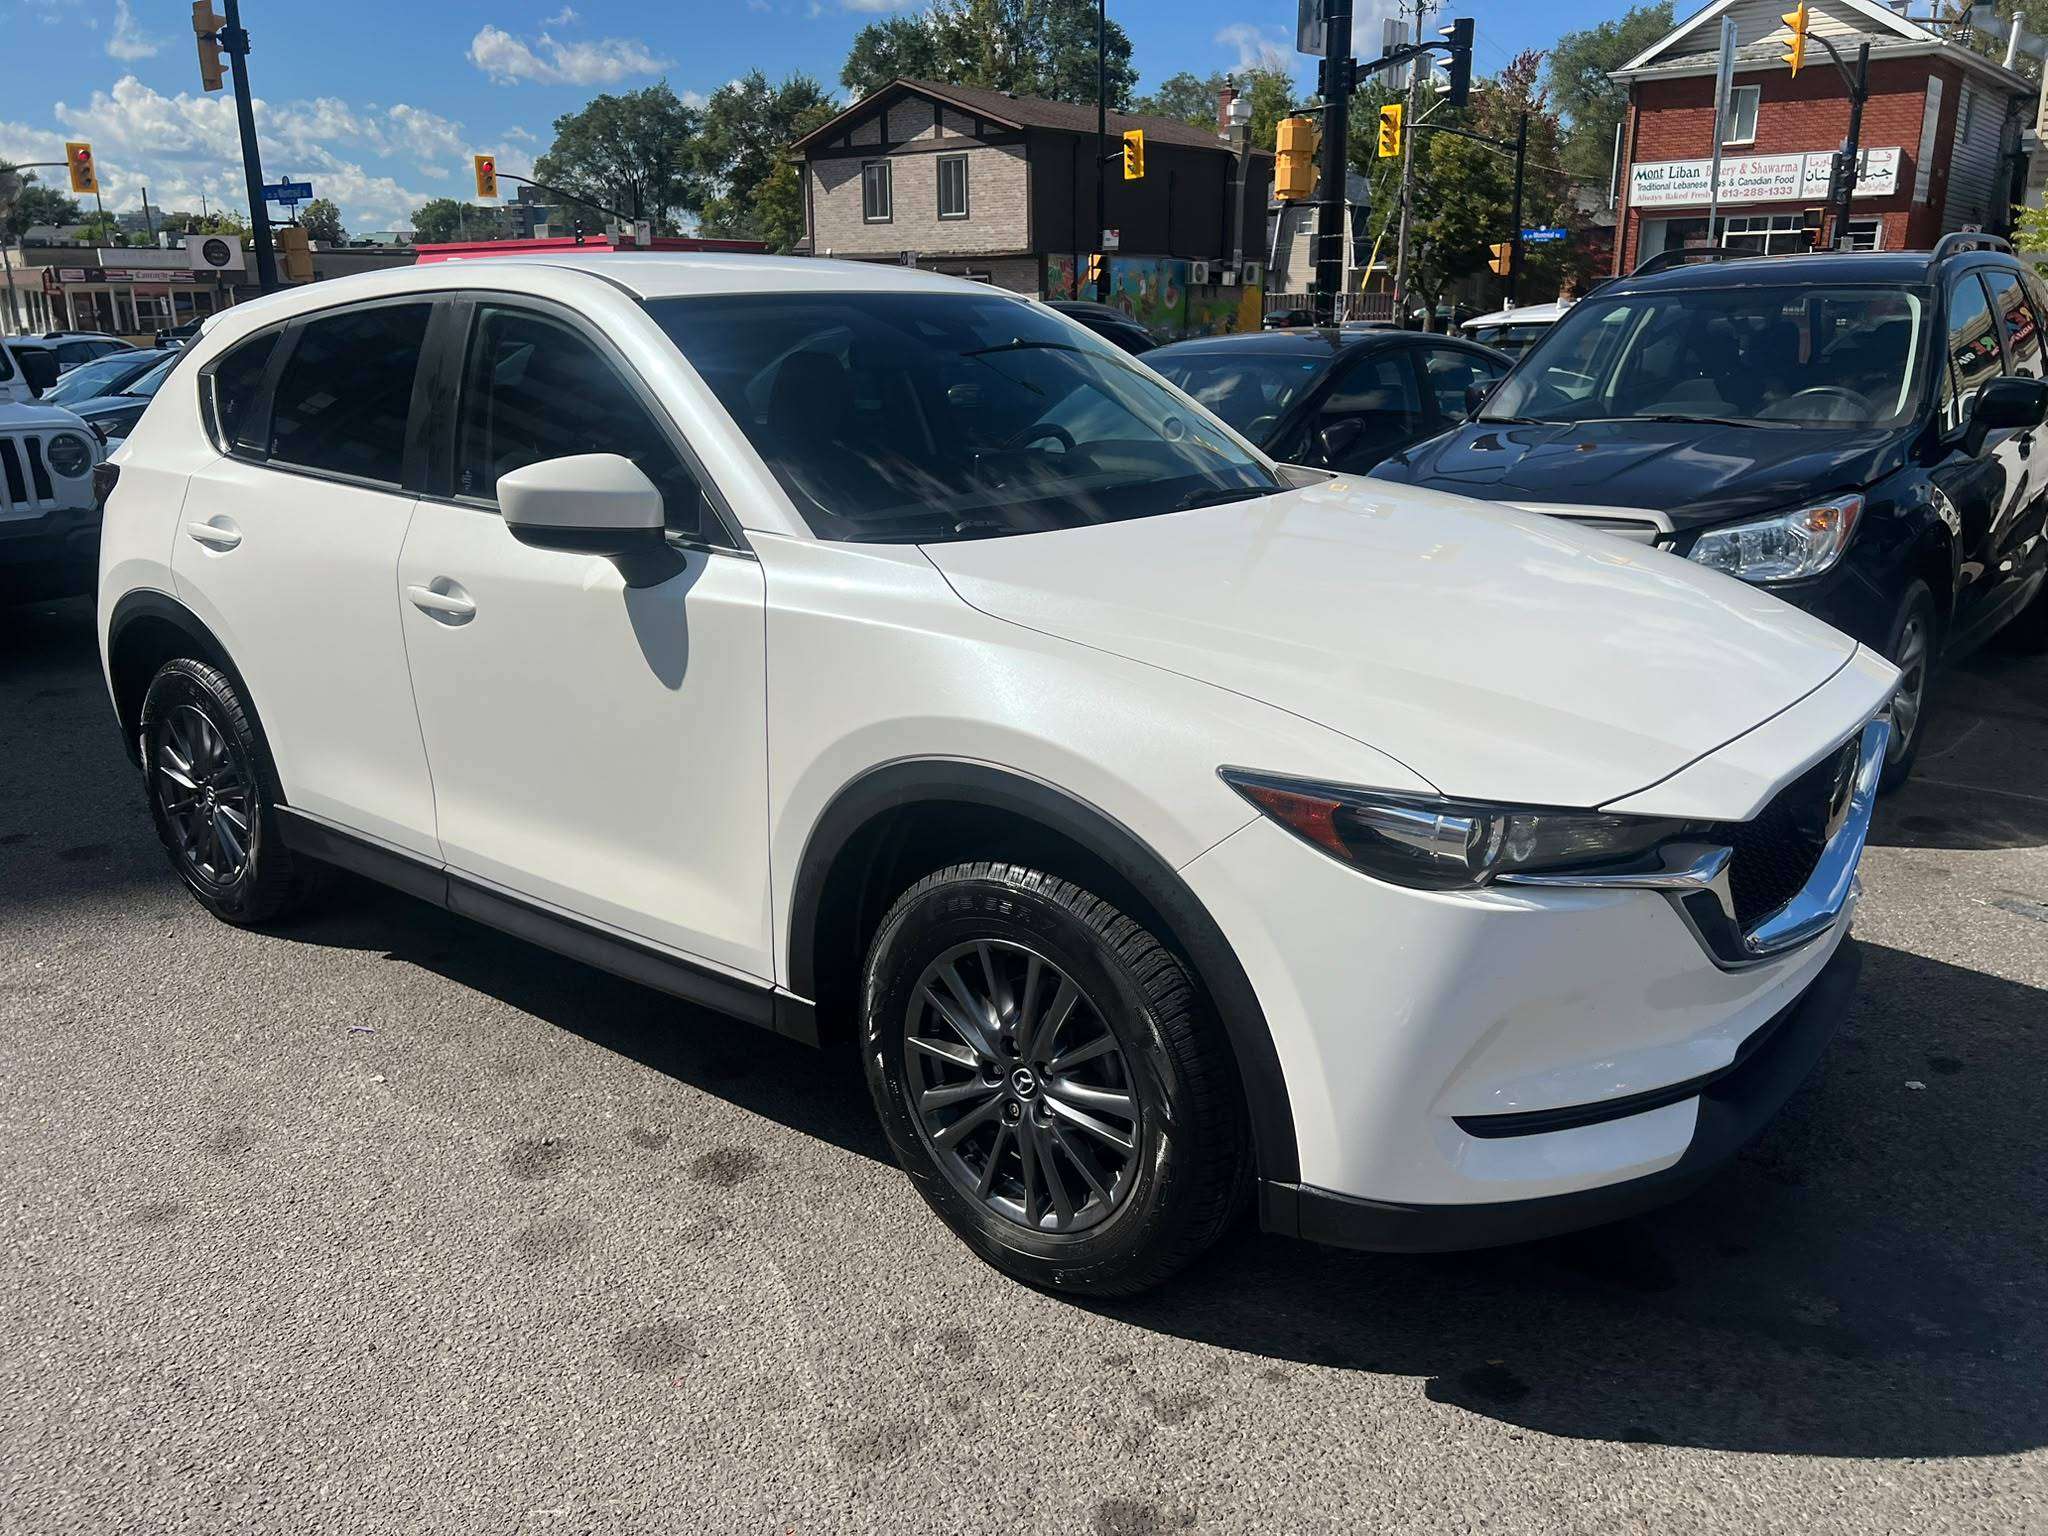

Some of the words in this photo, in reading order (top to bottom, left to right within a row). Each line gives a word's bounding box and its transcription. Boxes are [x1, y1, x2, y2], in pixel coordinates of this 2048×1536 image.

[1634, 167, 1664, 181] Mont
[1668, 166, 1700, 179] Liban
[1705, 164, 1736, 177] Bery
[1739, 162, 1748, 174] &
[1751, 161, 1798, 174] Shawarma
[1637, 181, 1671, 192] Traditional
[1673, 180, 1708, 190] Lebanese
[1728, 178, 1734, 186] &
[1737, 176, 1772, 186] Canadian
[1774, 174, 1794, 184] Food
[1637, 193, 1662, 202] Always
[1665, 192, 1688, 200] Baked
[1690, 190, 1711, 199] Fresh
[1721, 186, 1793, 198] 613-288-1333
